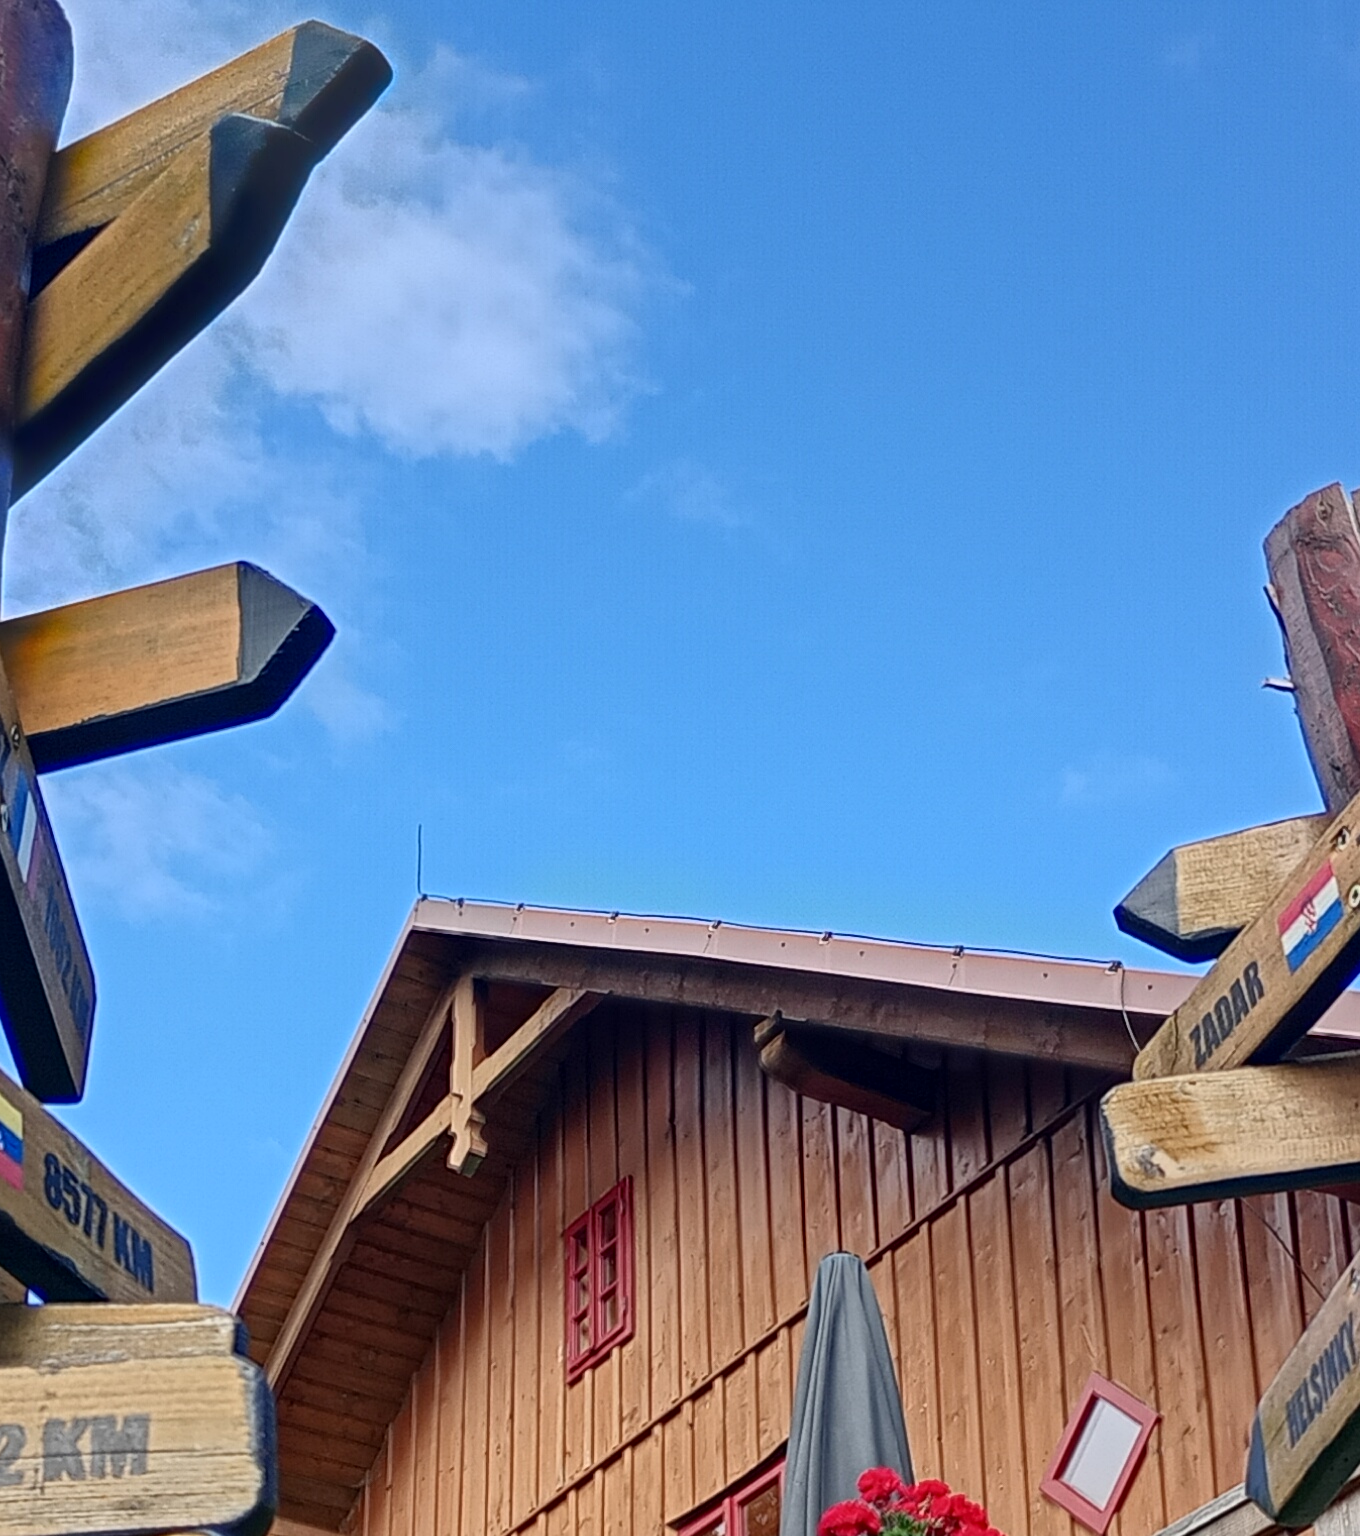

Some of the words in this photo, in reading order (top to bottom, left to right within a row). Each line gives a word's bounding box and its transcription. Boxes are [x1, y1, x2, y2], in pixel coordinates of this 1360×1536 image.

[1188, 961, 1265, 1068] ZADAR
[43, 1153, 108, 1250] 8577
[113, 1211, 155, 1292] KM
[1285, 1311, 1358, 1450] HELSINKY
[42, 1414, 150, 1481] KM
